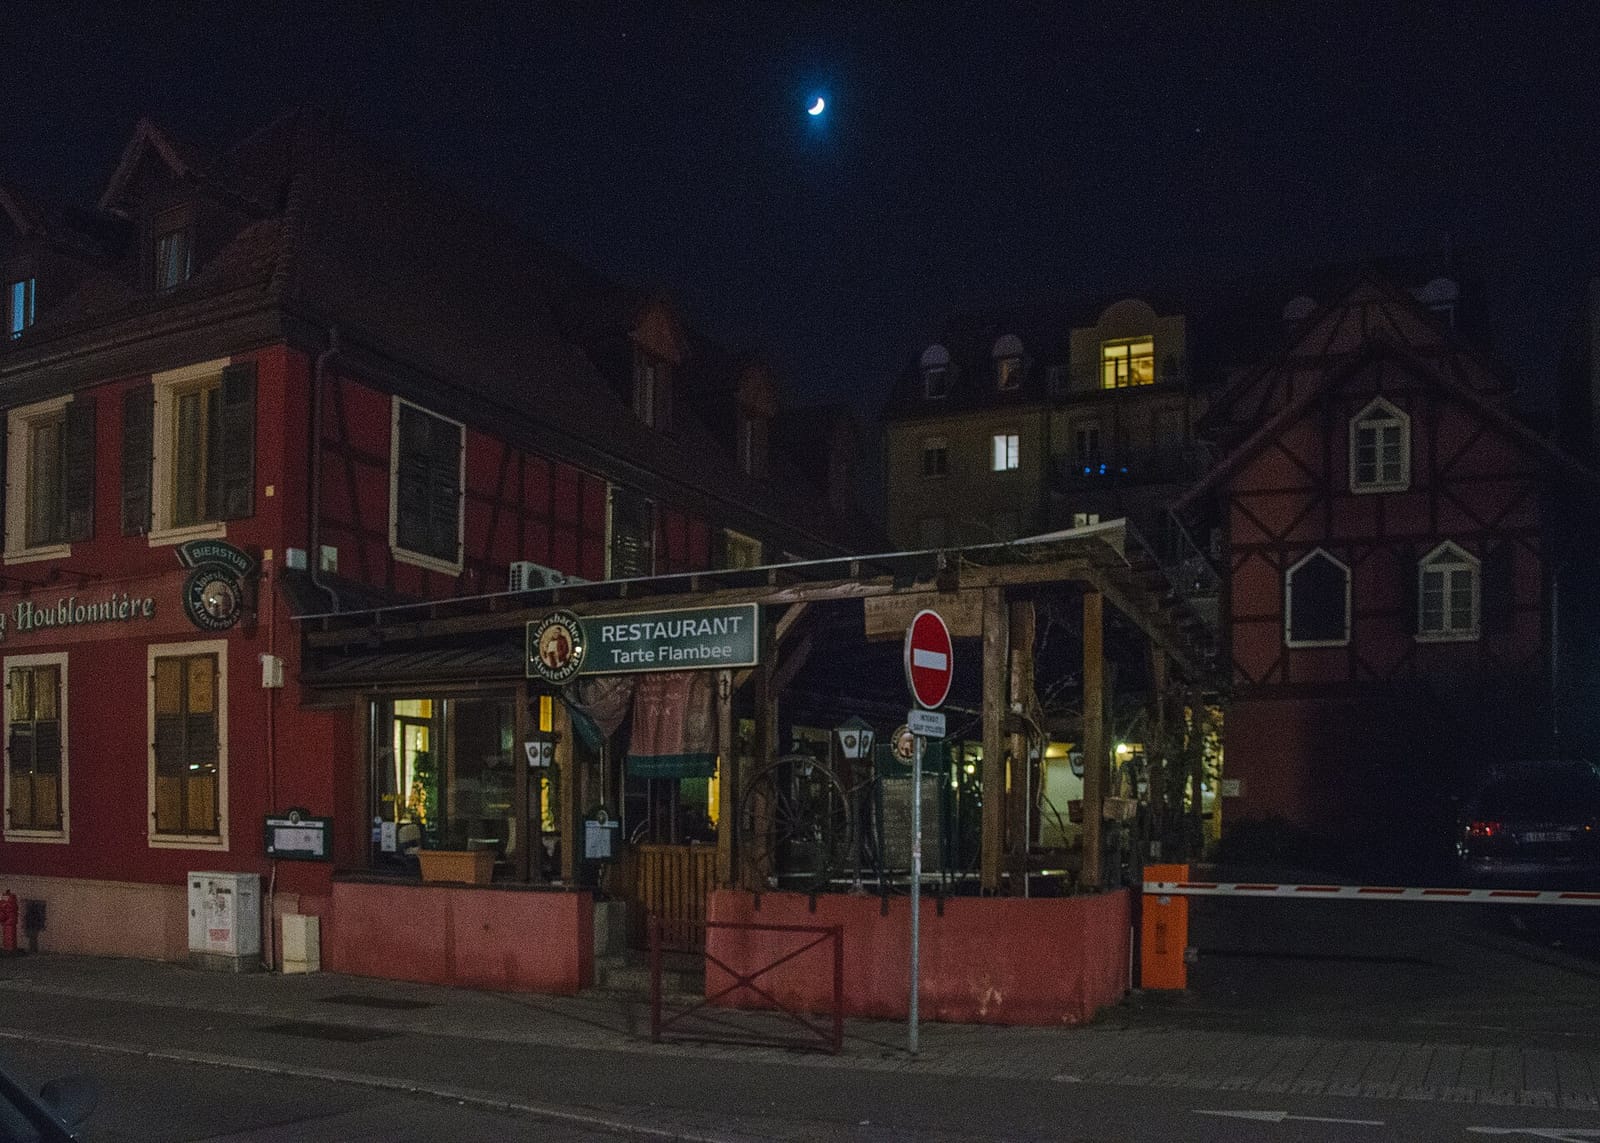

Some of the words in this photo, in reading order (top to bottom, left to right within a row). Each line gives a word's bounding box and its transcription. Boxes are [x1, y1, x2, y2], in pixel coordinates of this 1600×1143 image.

[192, 545, 247, 569] BIERSTUB
[601, 616, 743, 642] RESTAURANT
[610, 648, 655, 664] Tarte
[658, 644, 733, 661] Flambee
